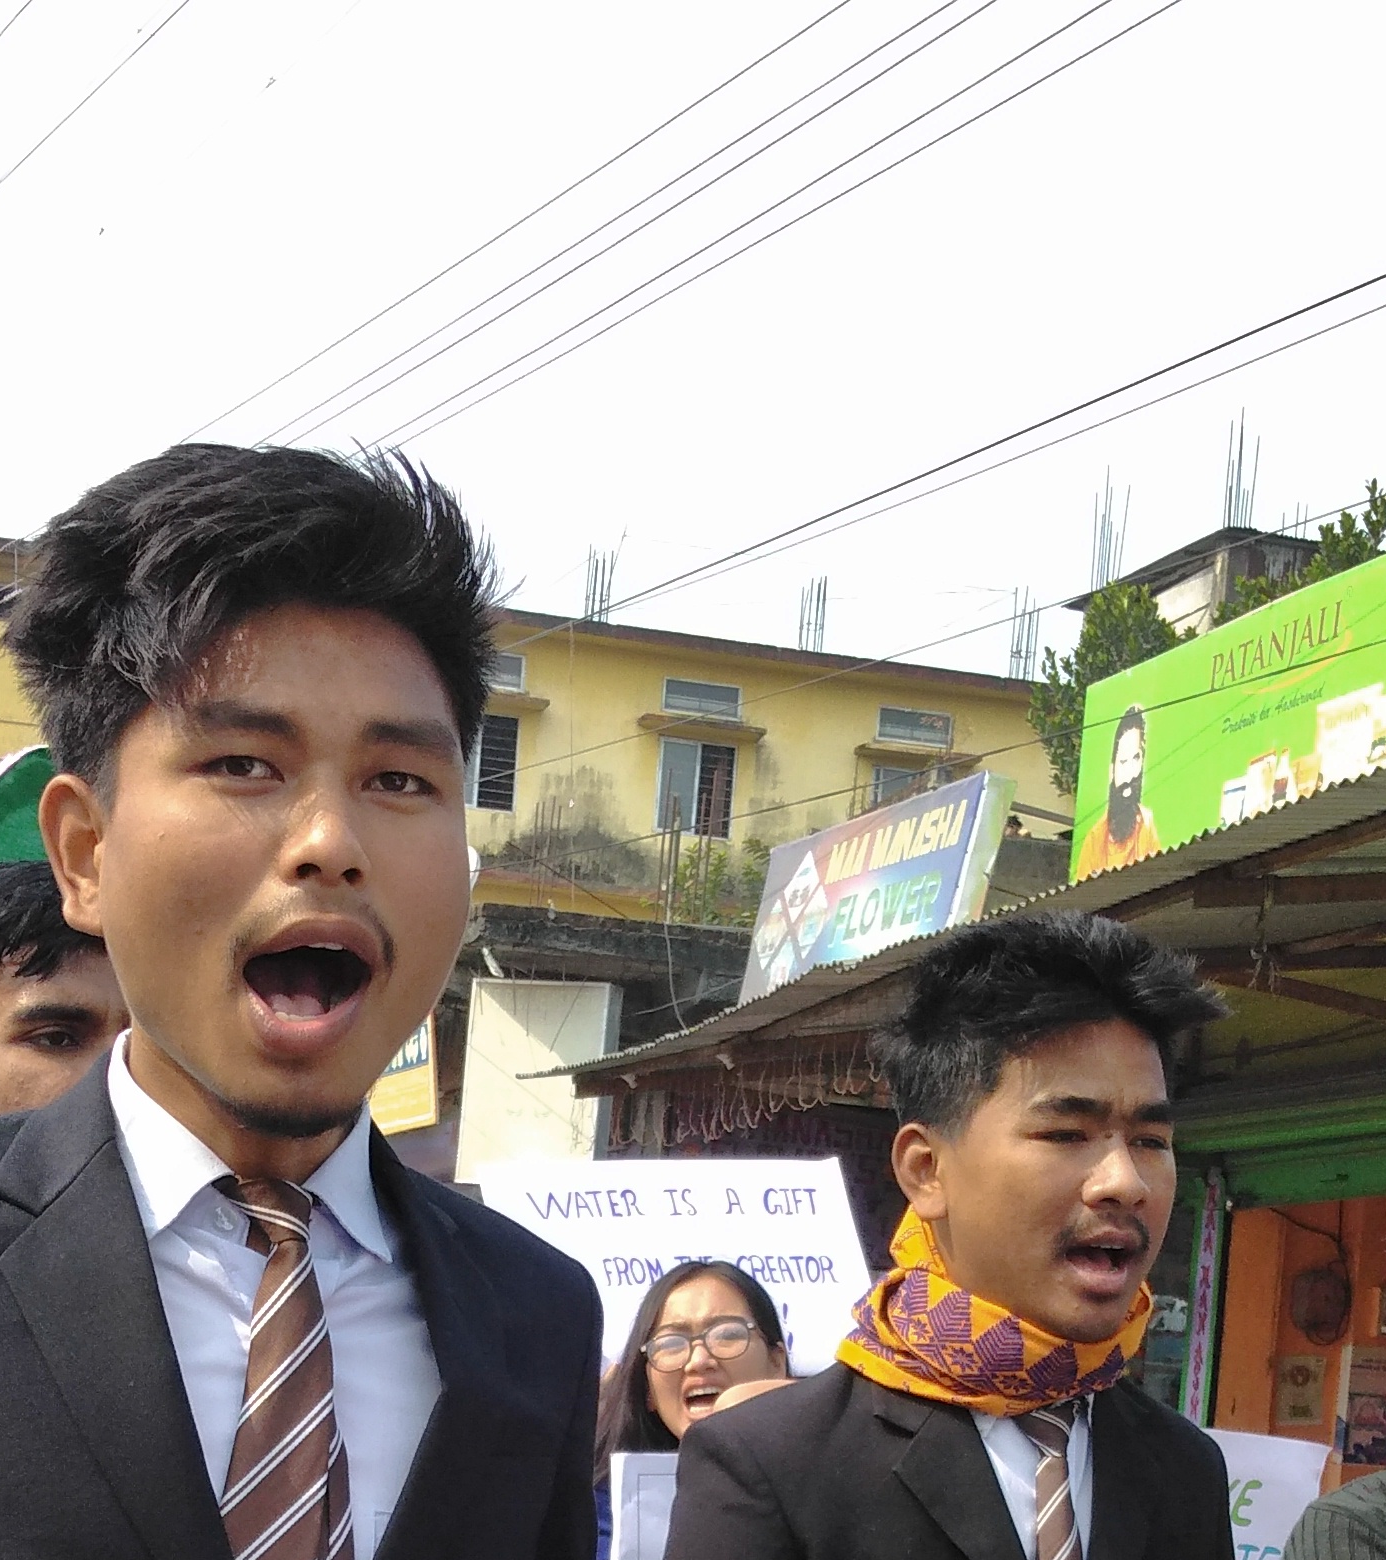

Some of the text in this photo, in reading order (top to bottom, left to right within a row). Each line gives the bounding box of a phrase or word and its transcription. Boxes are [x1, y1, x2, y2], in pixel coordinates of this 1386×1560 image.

[1208, 600, 1342, 692] PATANJALI
[824, 799, 968, 885] MAA MANASHA
[827, 870, 942, 949] FLOWER
[526, 1187, 818, 1220] WATER IS A GIFT
[602, 1256, 663, 1287] FROM
